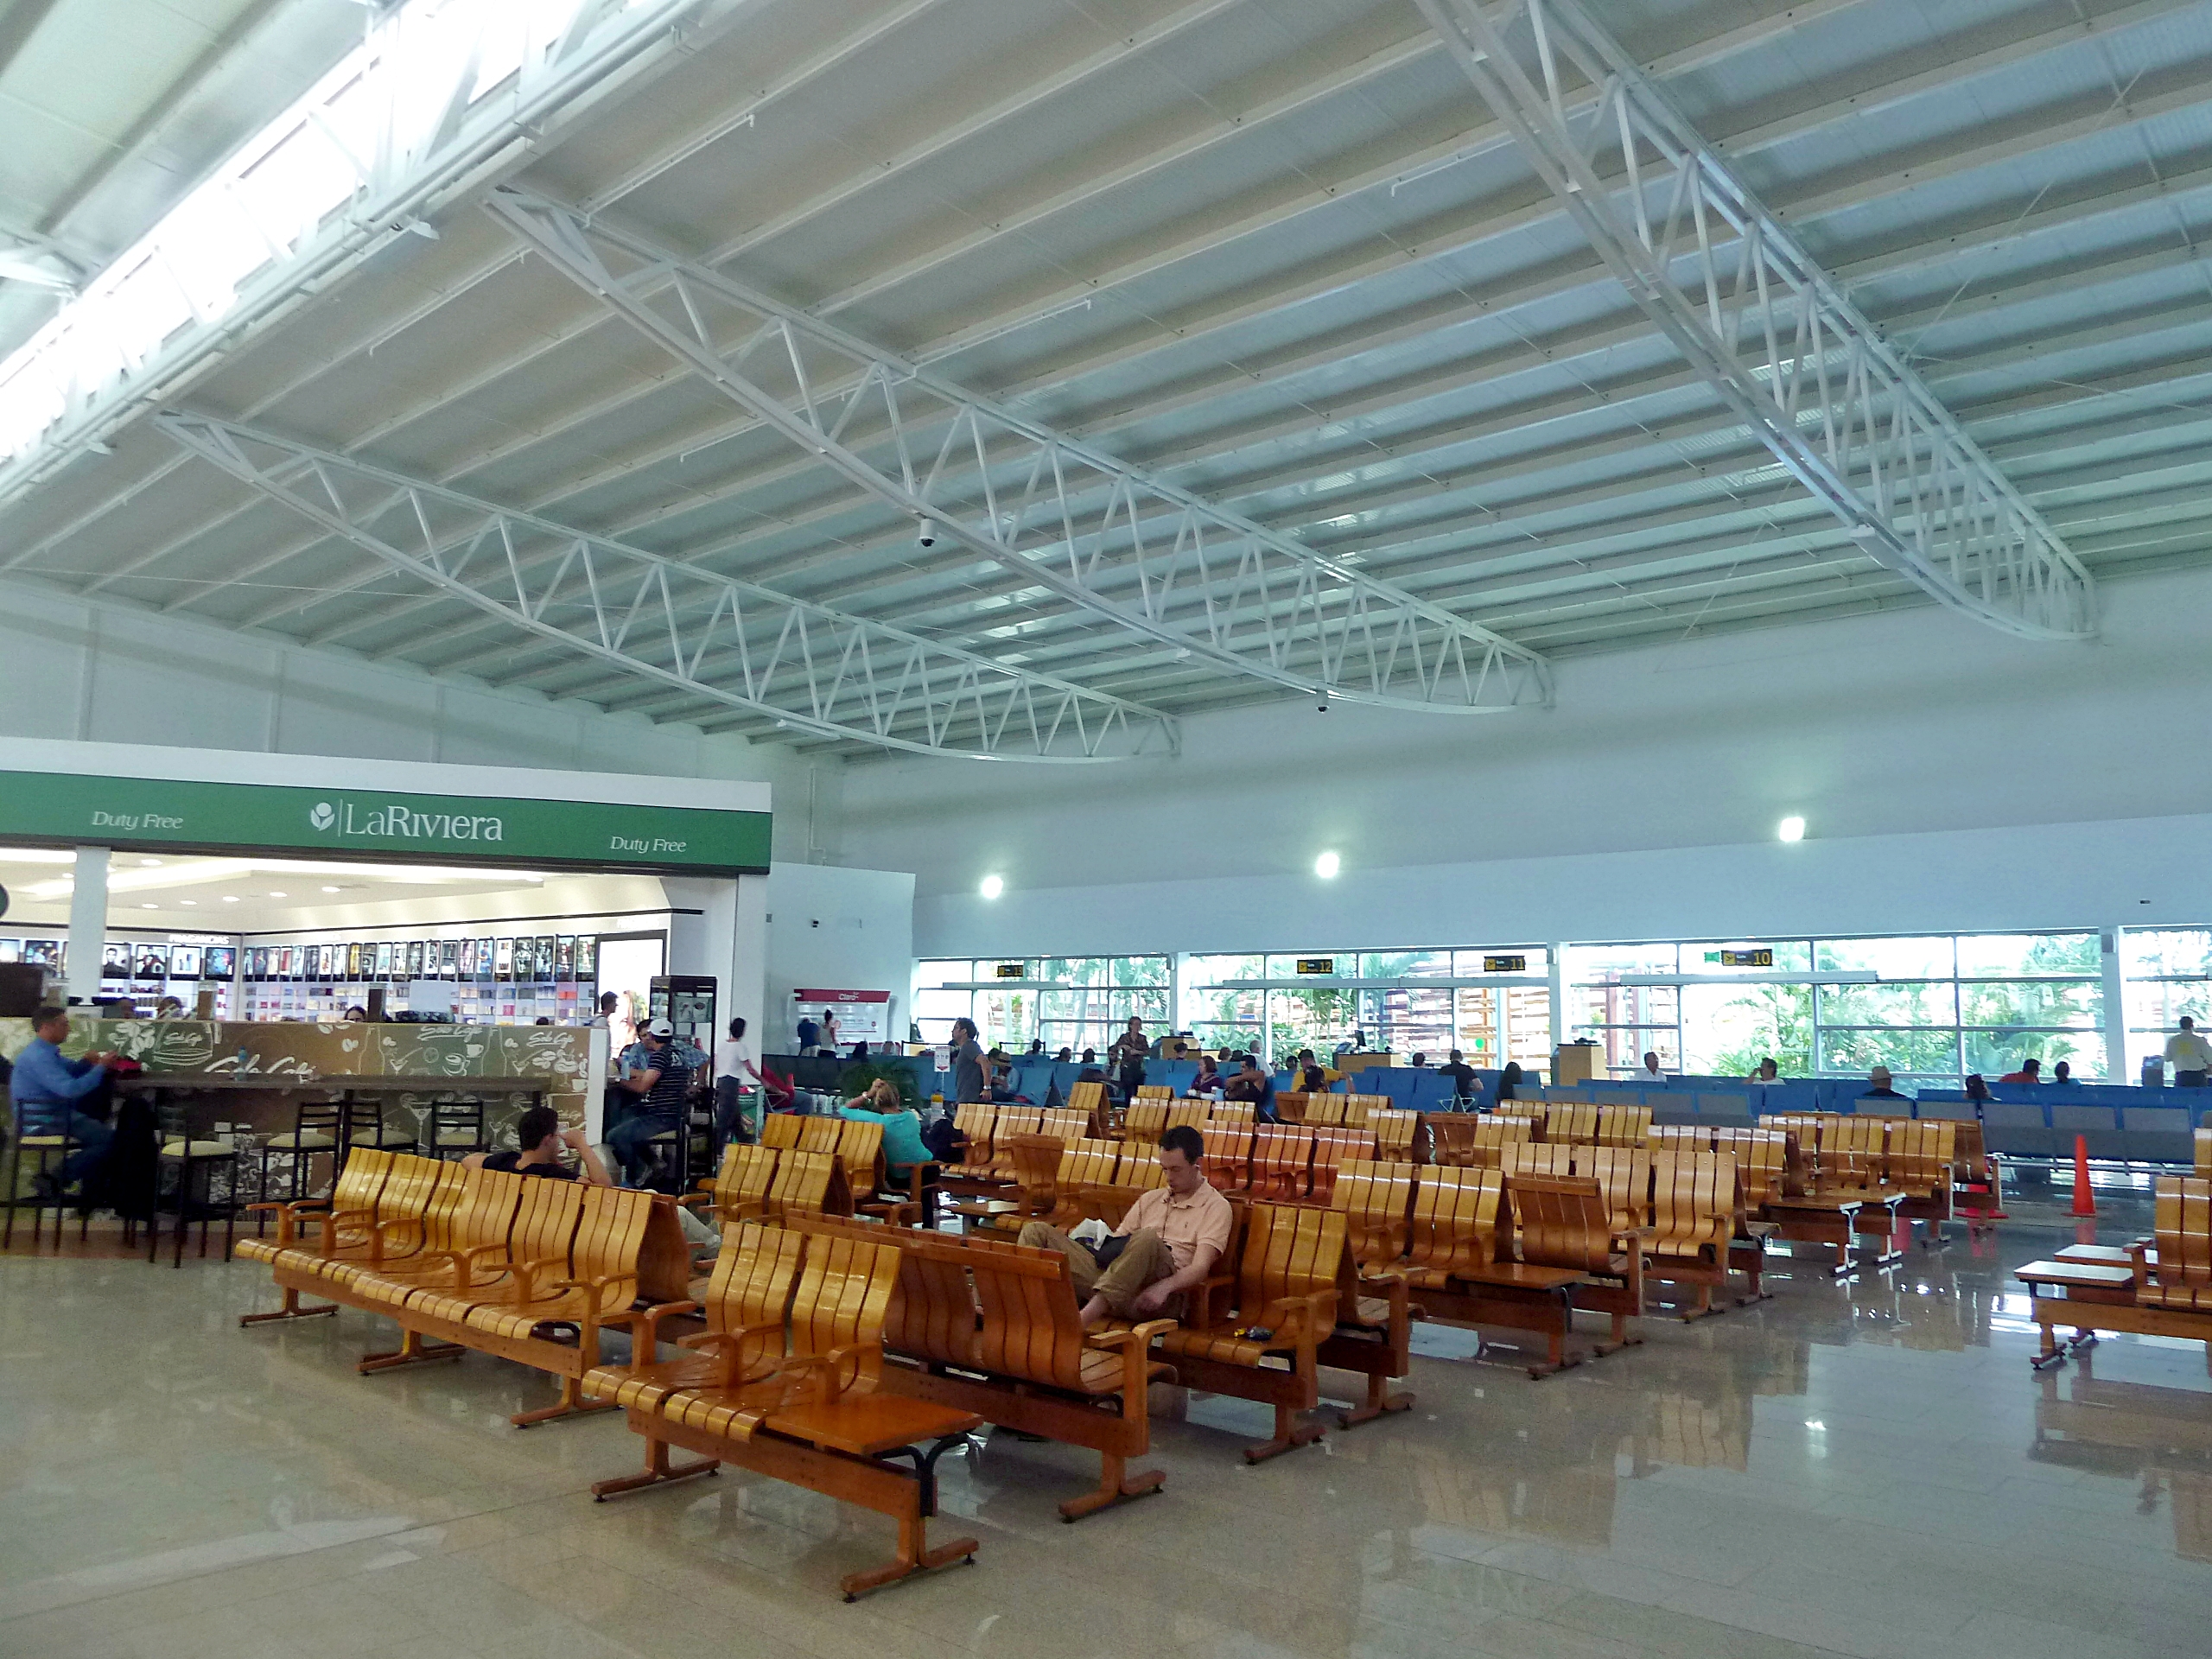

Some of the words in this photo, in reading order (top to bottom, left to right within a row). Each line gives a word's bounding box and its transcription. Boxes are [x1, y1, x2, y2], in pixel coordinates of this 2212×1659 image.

[92, 810, 139, 830] Duty
[143, 813, 184, 830] Free
[346, 803, 504, 842] LaRiviera
[610, 836, 650, 854] Duty
[652, 838, 687, 853] Free
[1510, 958, 1524, 969] 11
[1753, 952, 1770, 965] 10
[1319, 961, 1332, 972] 12
